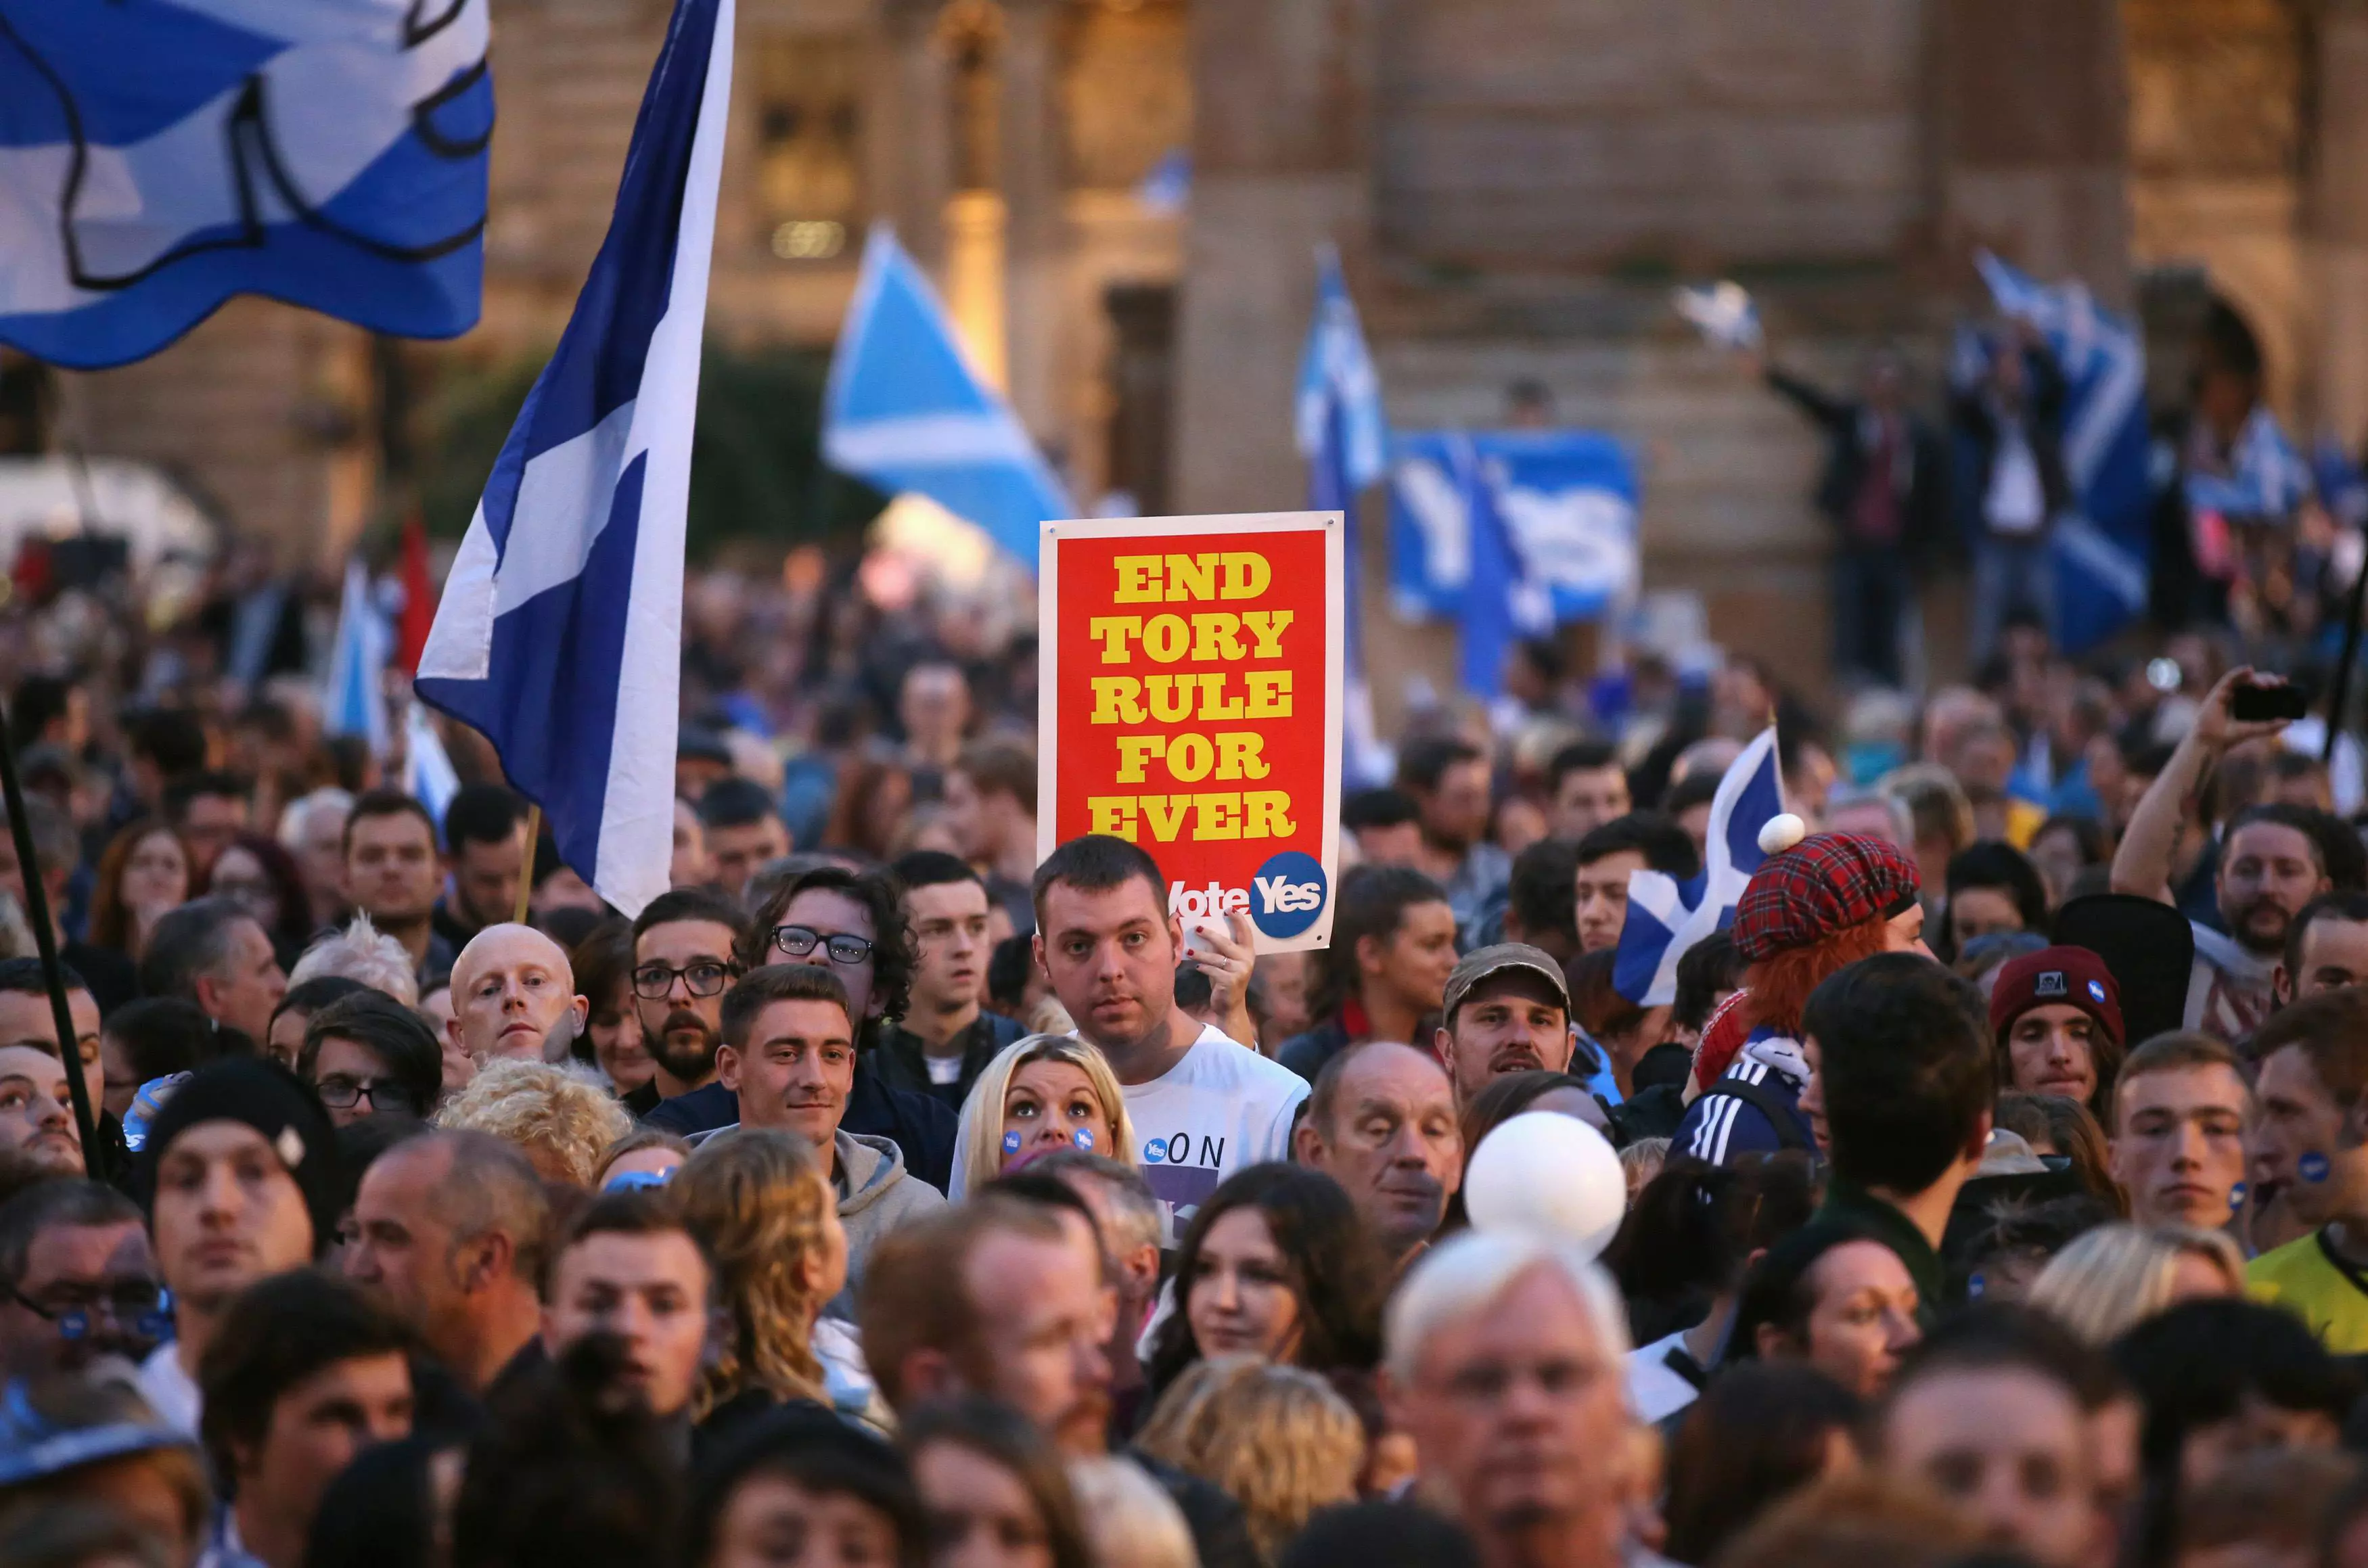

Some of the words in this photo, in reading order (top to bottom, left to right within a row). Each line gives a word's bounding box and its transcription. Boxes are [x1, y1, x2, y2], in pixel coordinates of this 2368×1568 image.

[1114, 551, 1271, 603] END
[1090, 609, 1294, 664] TORY
[1091, 670, 1293, 724] RULE
[1116, 731, 1270, 784] FOR
[1087, 790, 1296, 843] EVER
[1253, 875, 1321, 914] Yes
[1005, 1136, 1018, 1148] Yes
[1148, 1143, 1166, 1157] Yes
